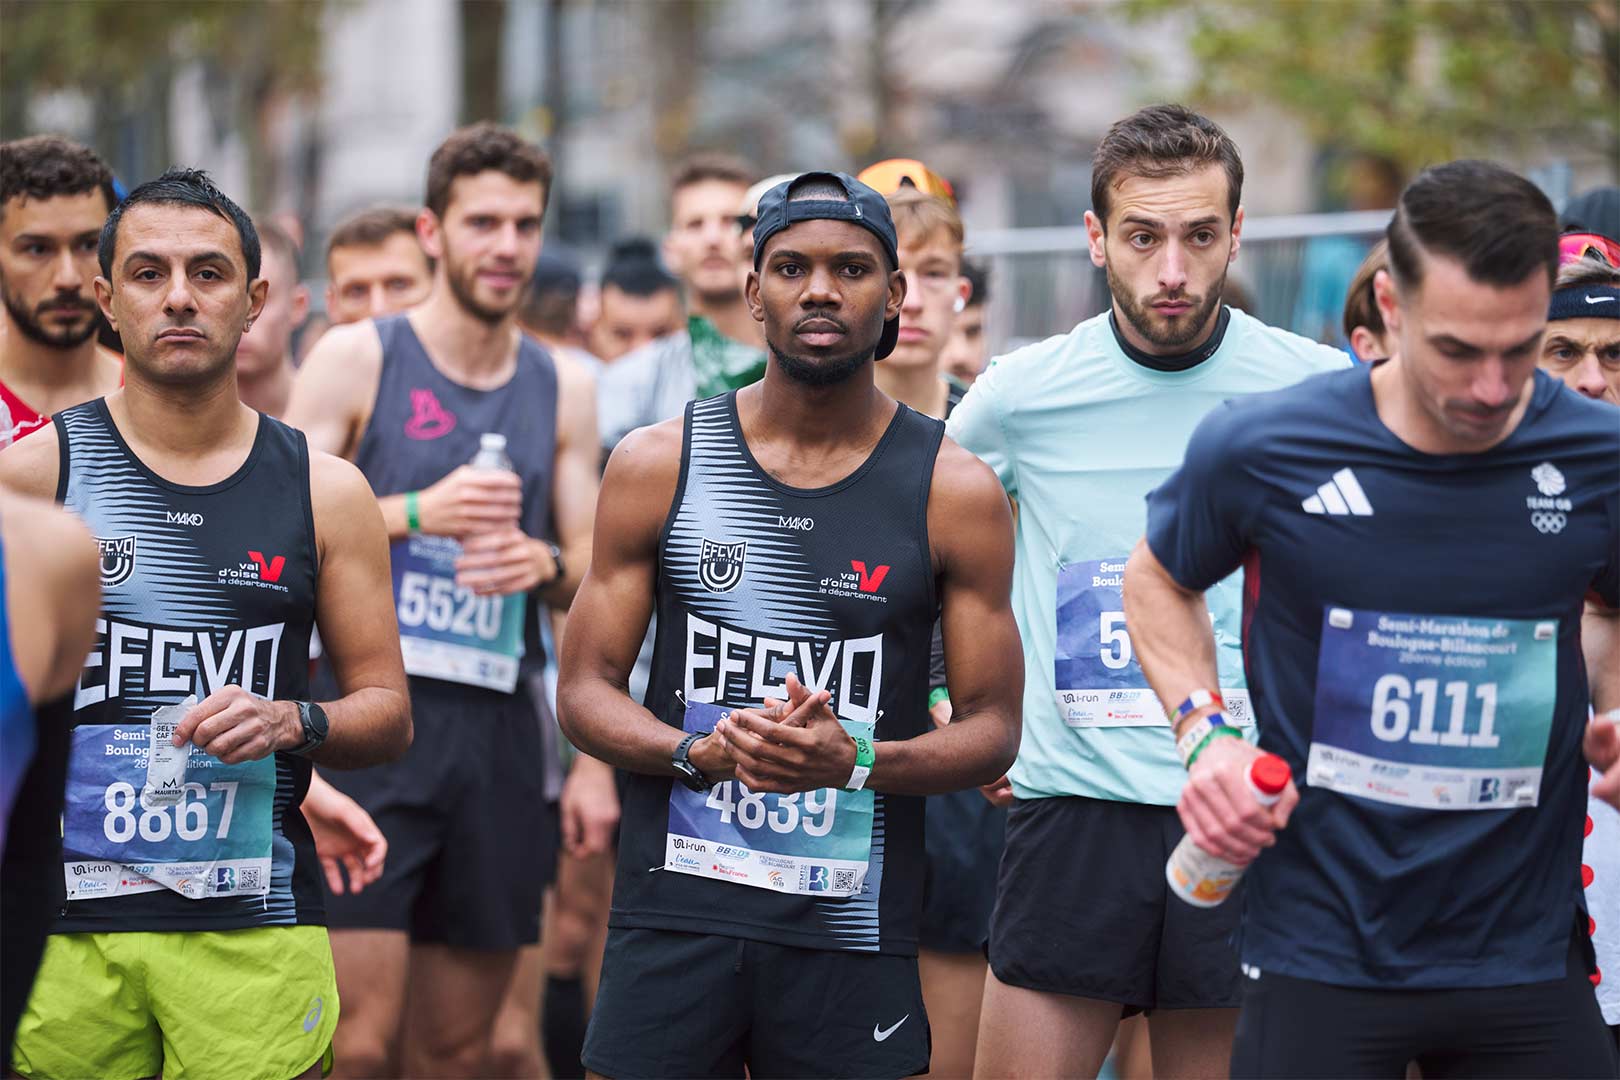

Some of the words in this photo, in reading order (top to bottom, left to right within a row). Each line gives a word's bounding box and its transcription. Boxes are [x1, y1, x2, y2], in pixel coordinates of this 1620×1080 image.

[92, 537, 134, 556] FCVO
[702, 542, 747, 562] EFCVO
[218, 568, 259, 580] d'oise
[239, 562, 259, 571] val
[227, 577, 289, 593] département
[820, 577, 858, 590] d'oise
[840, 572, 859, 581] val
[819, 586, 827, 594] le
[828, 588, 888, 603] département
[397, 570, 504, 640] 5520
[1100, 611, 1132, 669] 5
[684, 612, 883, 722] EFCVO
[1370, 673, 1501, 749] 6111
[156, 732, 170, 740] CAF
[105, 744, 150, 758] Boulog
[134, 759, 149, 769] 28
[103, 781, 240, 844] 8867
[705, 780, 837, 838] 4839
